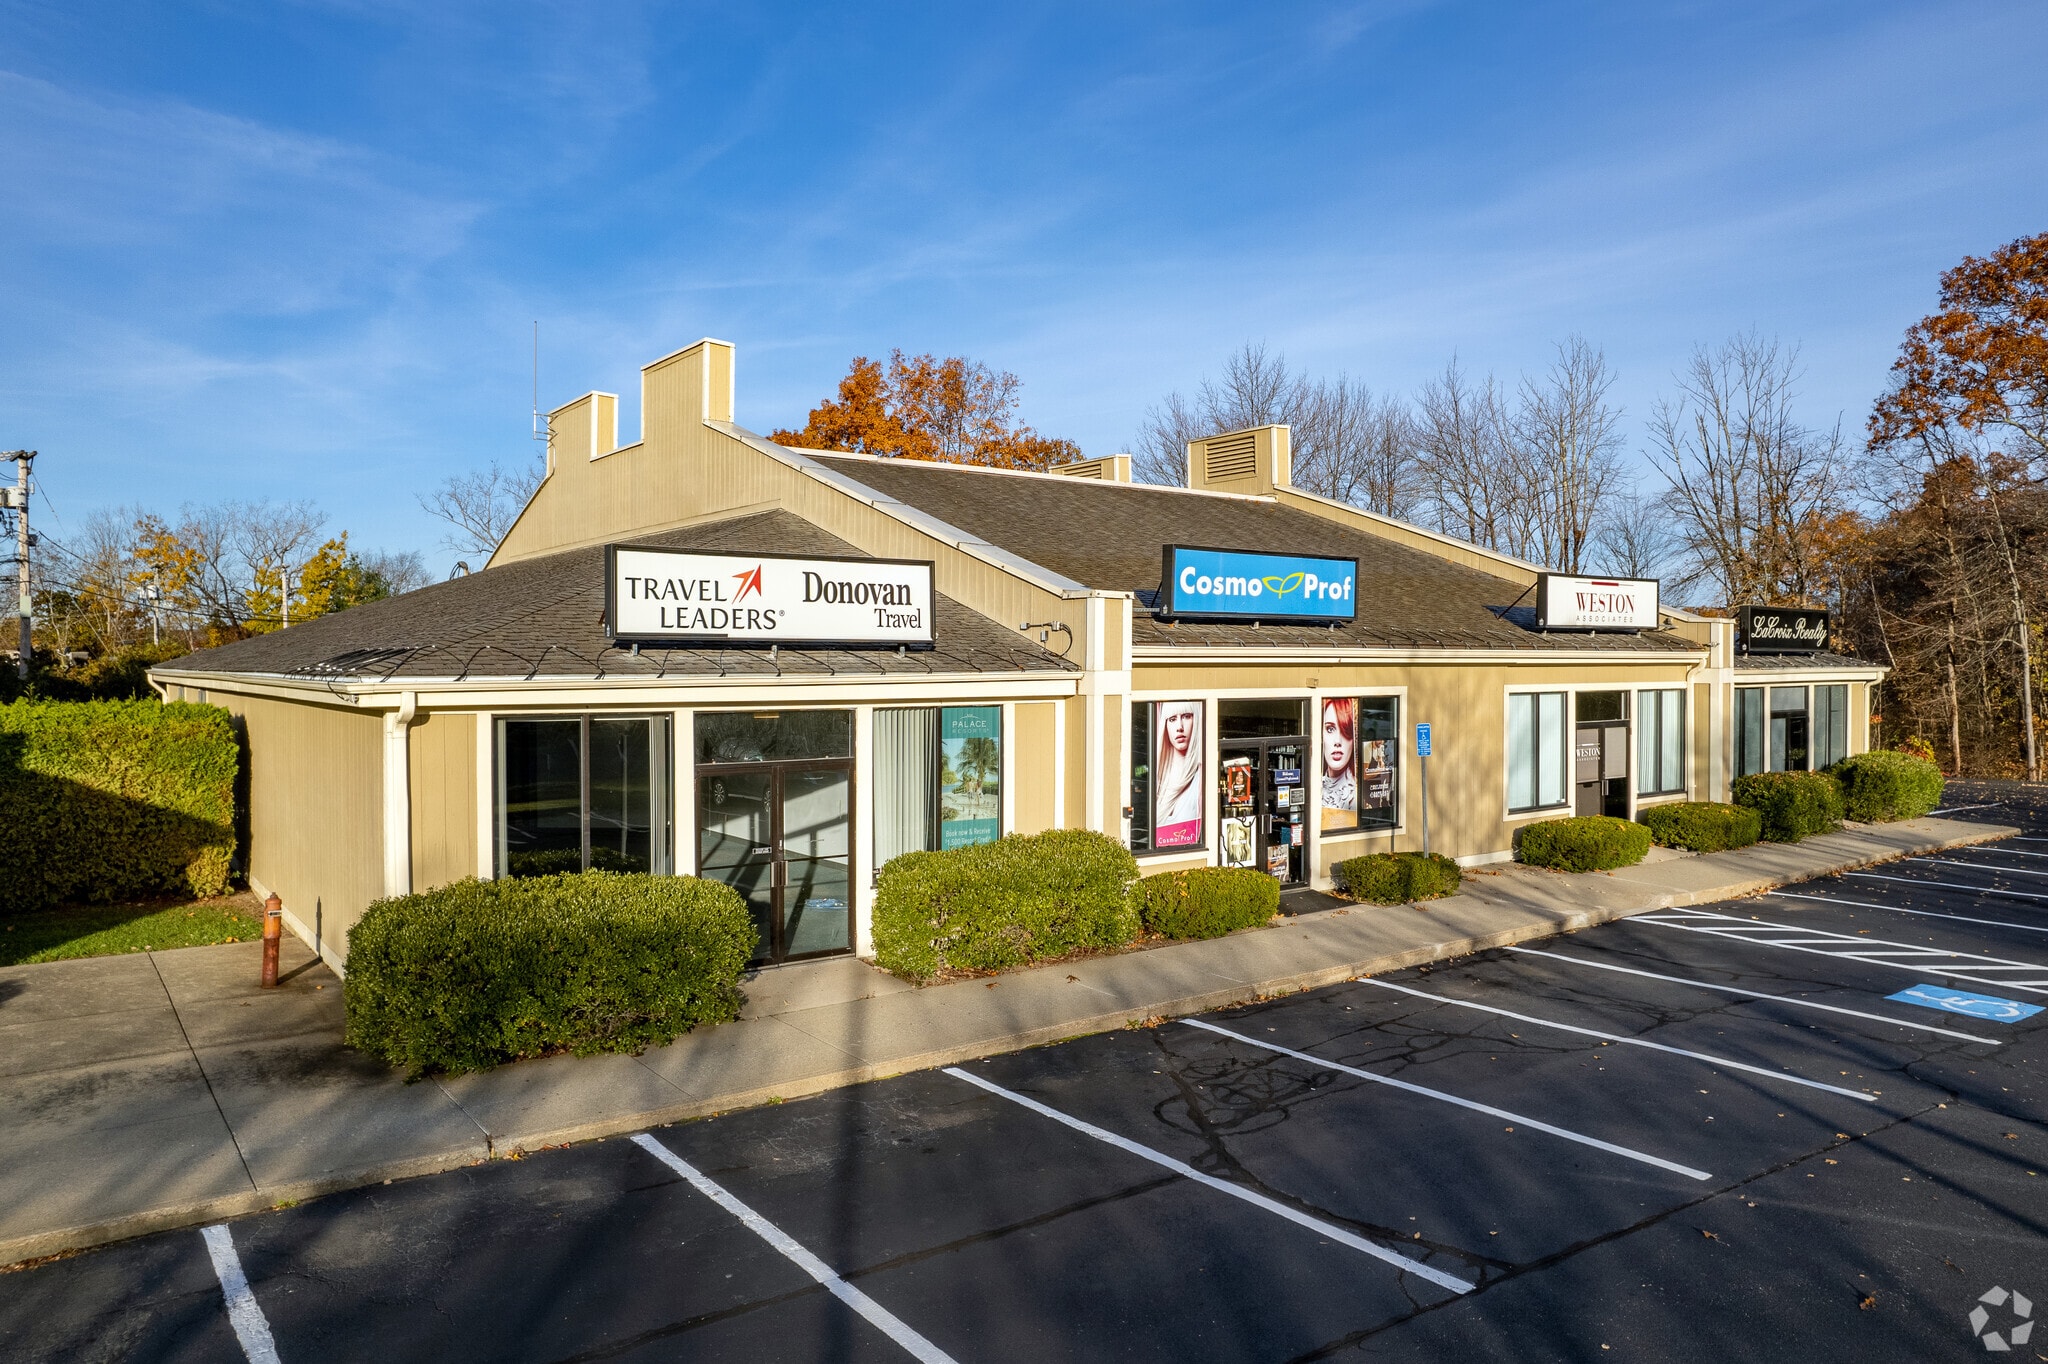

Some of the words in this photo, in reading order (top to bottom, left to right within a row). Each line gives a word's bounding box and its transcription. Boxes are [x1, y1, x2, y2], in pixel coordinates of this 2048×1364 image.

[625, 577, 728, 602] TRAVEL
[802, 571, 912, 606] Donovan
[1180, 566, 1263, 597] Cosmo
[1304, 573, 1352, 600] Prof
[1576, 592, 1635, 613] WESTON
[874, 608, 922, 628] Travel
[1576, 615, 1633, 623] ASSOCIATES
[1792, 617, 1827, 647] Realty
[952, 720, 987, 728] PALACE
[1576, 747, 1600, 757] WESTON
